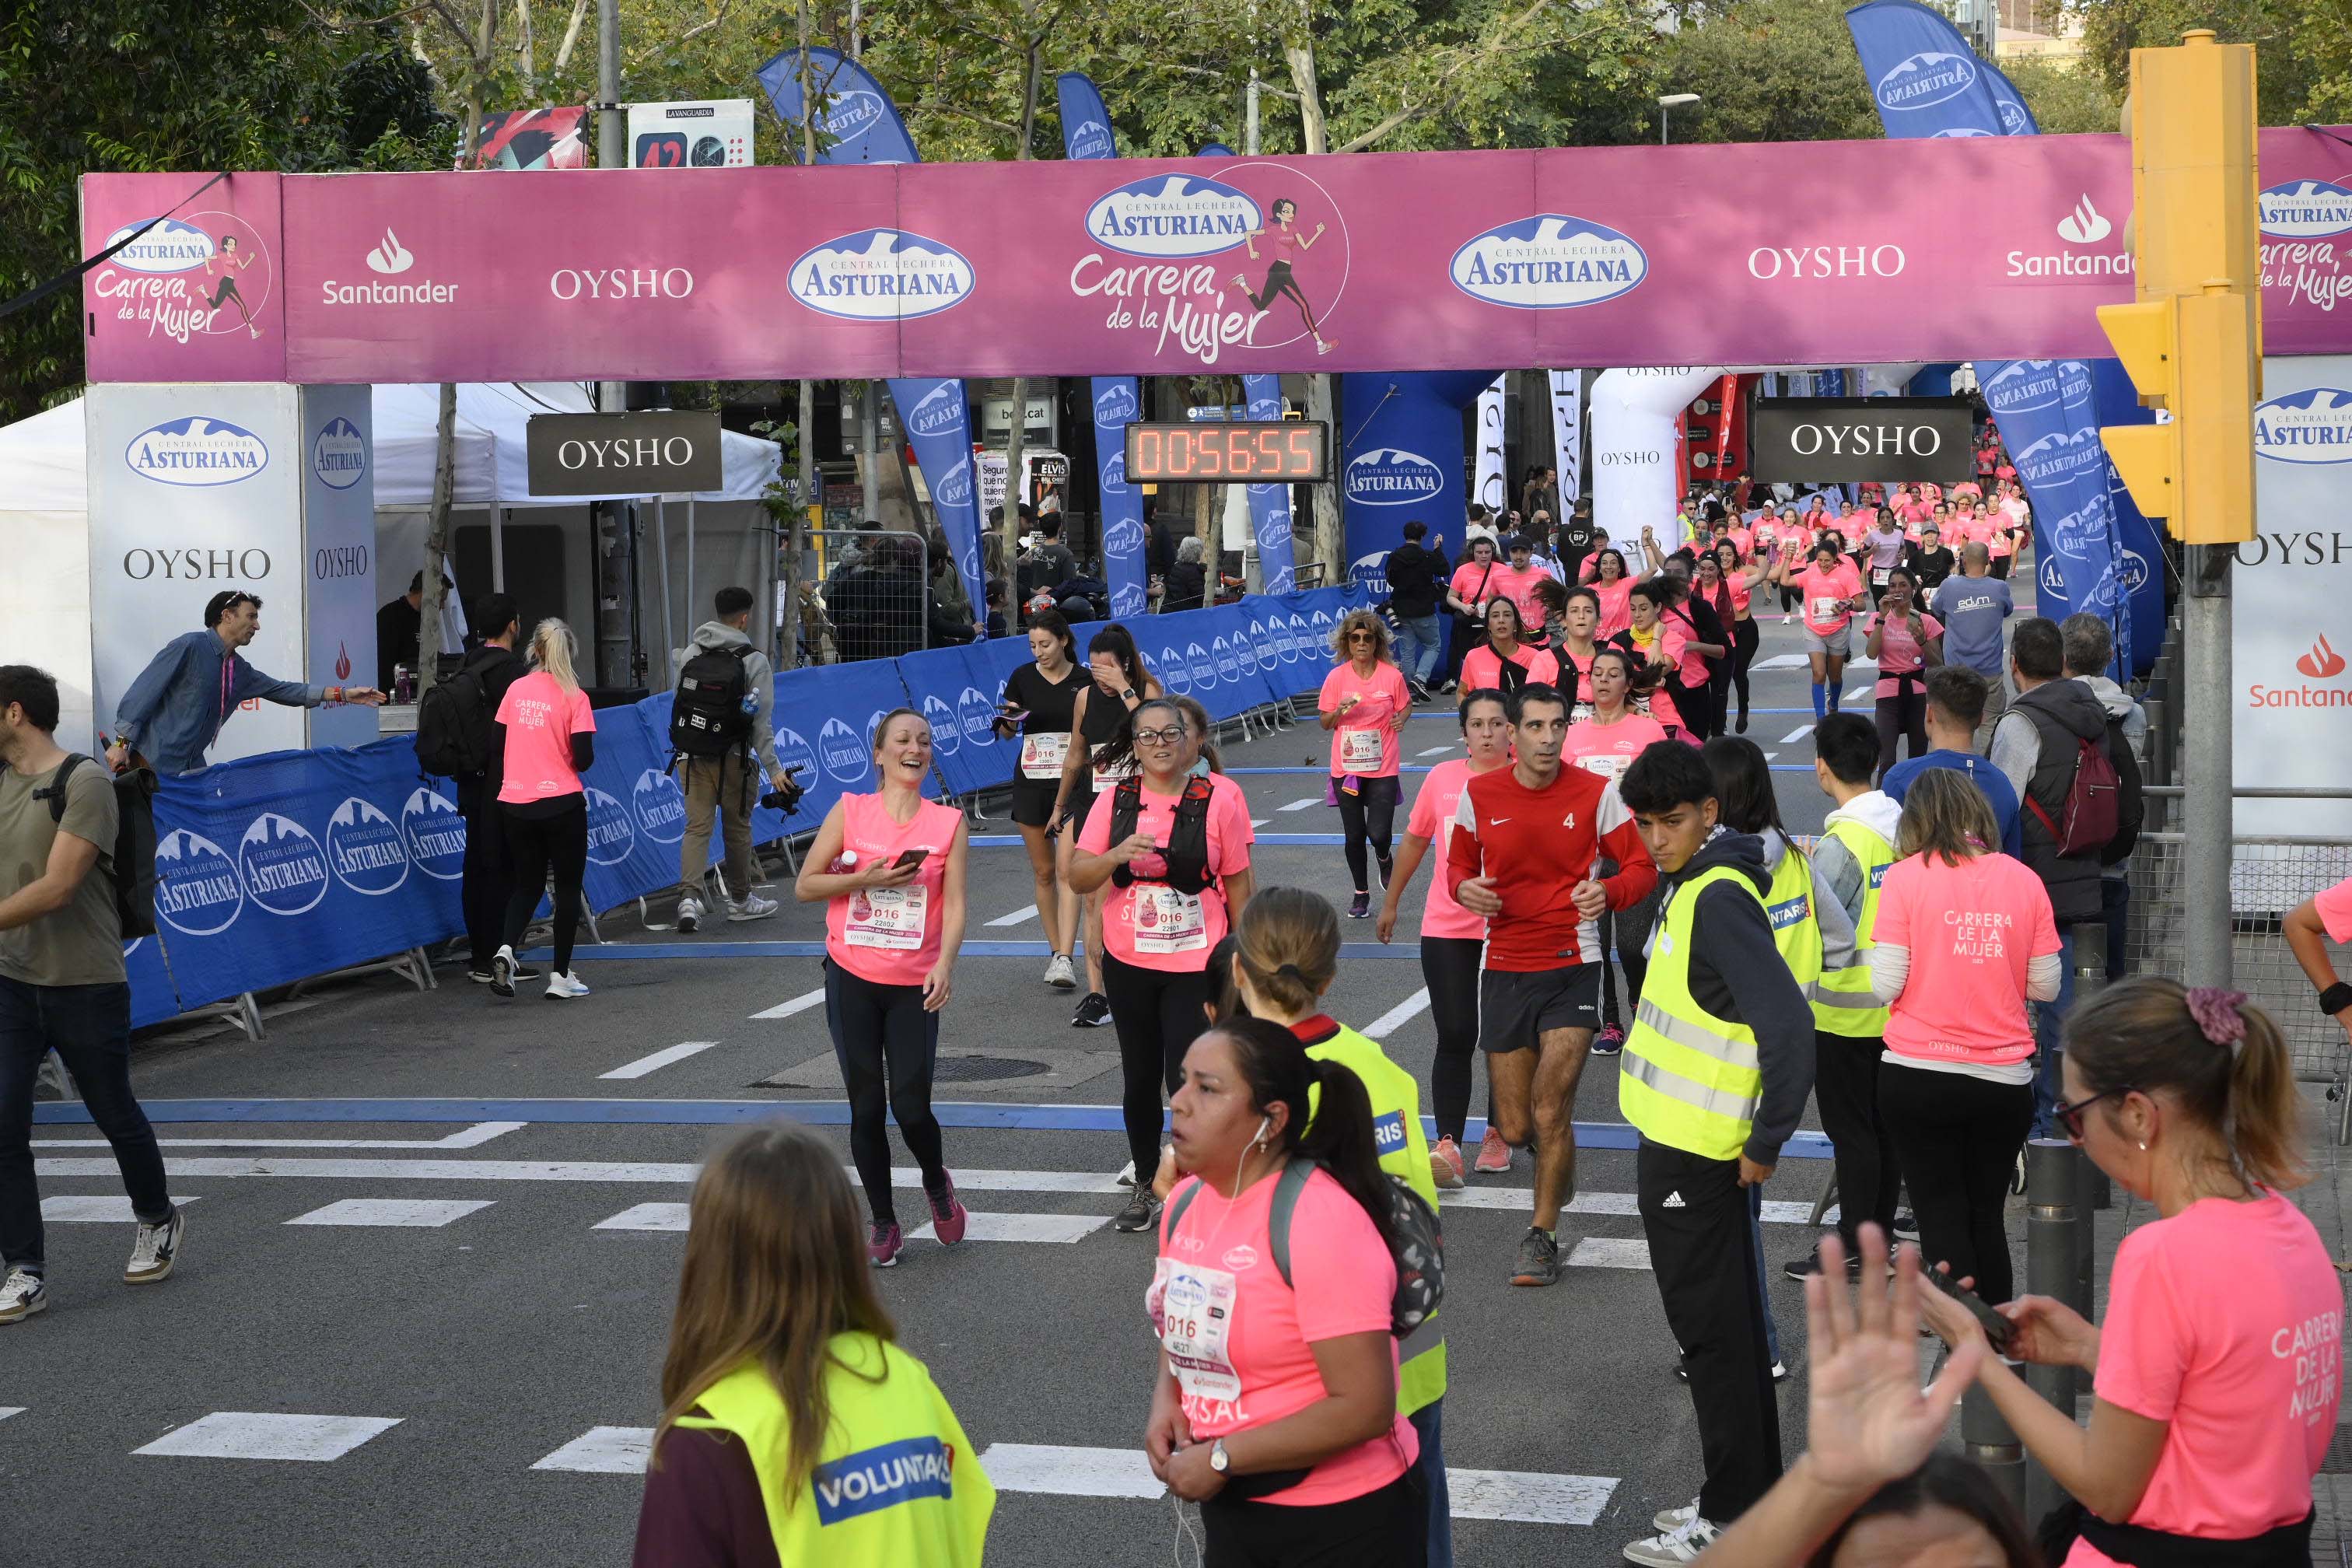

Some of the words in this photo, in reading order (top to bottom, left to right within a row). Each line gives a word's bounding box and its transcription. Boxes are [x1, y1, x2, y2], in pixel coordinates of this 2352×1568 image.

[675, 107, 713, 117] VANGUARDIA
[1125, 202, 1181, 212] CENTRAL
[1187, 201, 1243, 210] LECHERA
[1098, 205, 1248, 237] ASTURIANA
[1495, 247, 1556, 258] CENTRAL
[1562, 245, 1626, 256] LECHERA
[1748, 244, 1906, 279] OYSHO
[2007, 250, 2135, 277] Santand
[2259, 242, 2333, 265] arrera
[830, 260, 890, 270] CENTRAL
[893, 258, 955, 269] LECHERA
[1070, 254, 1216, 297] Carrera
[1465, 250, 1633, 286] ASTURIANA
[94, 269, 187, 298] Carrera
[323, 279, 459, 304] Santander
[550, 268, 694, 300] OYSHO
[802, 262, 961, 298] ASTURIANA
[2278, 265, 2292, 287] la
[2288, 261, 2352, 312] Muje
[117, 299, 135, 320] de
[138, 299, 151, 320] la
[148, 294, 222, 344] Mujer
[1106, 299, 1133, 330] de
[1139, 298, 1158, 330] la
[1154, 291, 1270, 365] Mujer
[1790, 424, 1941, 457] OYSHO
[2254, 418, 2352, 446] ASTURI
[137, 443, 258, 468] ASTURIANA
[317, 443, 363, 472] ASTURIANA
[558, 436, 693, 470] OYSHO
[1138, 430, 1311, 473] 00:56:55
[1601, 450, 1660, 466] OYSHO
[1041, 464, 1066, 474] ELVIS
[983, 477, 996, 486] que
[984, 486, 1006, 497] quiere
[1348, 471, 1437, 493] ASTURIANA
[984, 497, 1004, 506] mete
[2234, 531, 2352, 566] OYSH
[123, 548, 271, 579] OYSHO
[315, 544, 368, 580] OYSHO
[515, 698, 552, 713] CARRERA
[2249, 684, 2352, 708] Santan
[518, 716, 545, 728] MUJER
[520, 708, 530, 716] DE
[533, 709, 544, 719] LA
[823, 744, 866, 769] ASTURIANA
[1563, 812, 1575, 829] 4
[341, 831, 369, 843] CENTRAL
[255, 847, 282, 863] CENTRAL
[284, 842, 313, 855] LECHERA
[334, 837, 406, 875] ASTURIANA
[166, 863, 197, 879] CENTRAL
[247, 856, 325, 894] ASTURIANA
[158, 873, 240, 915] ASTURIANA
[873, 908, 899, 919] 016
[874, 919, 895, 928] 22802
[1160, 912, 1182, 923] 016
[1770, 902, 1806, 924] NTARIS
[1944, 910, 2013, 928] CARRERA
[1958, 927, 1974, 941] DE
[1981, 927, 2000, 942] LA
[1953, 942, 2004, 958] MUJER
[1928, 1040, 1970, 1055] OYSHO
[1167, 1315, 1196, 1339] 016
[2296, 1350, 2317, 1386] DE
[2321, 1345, 2336, 1374] LA
